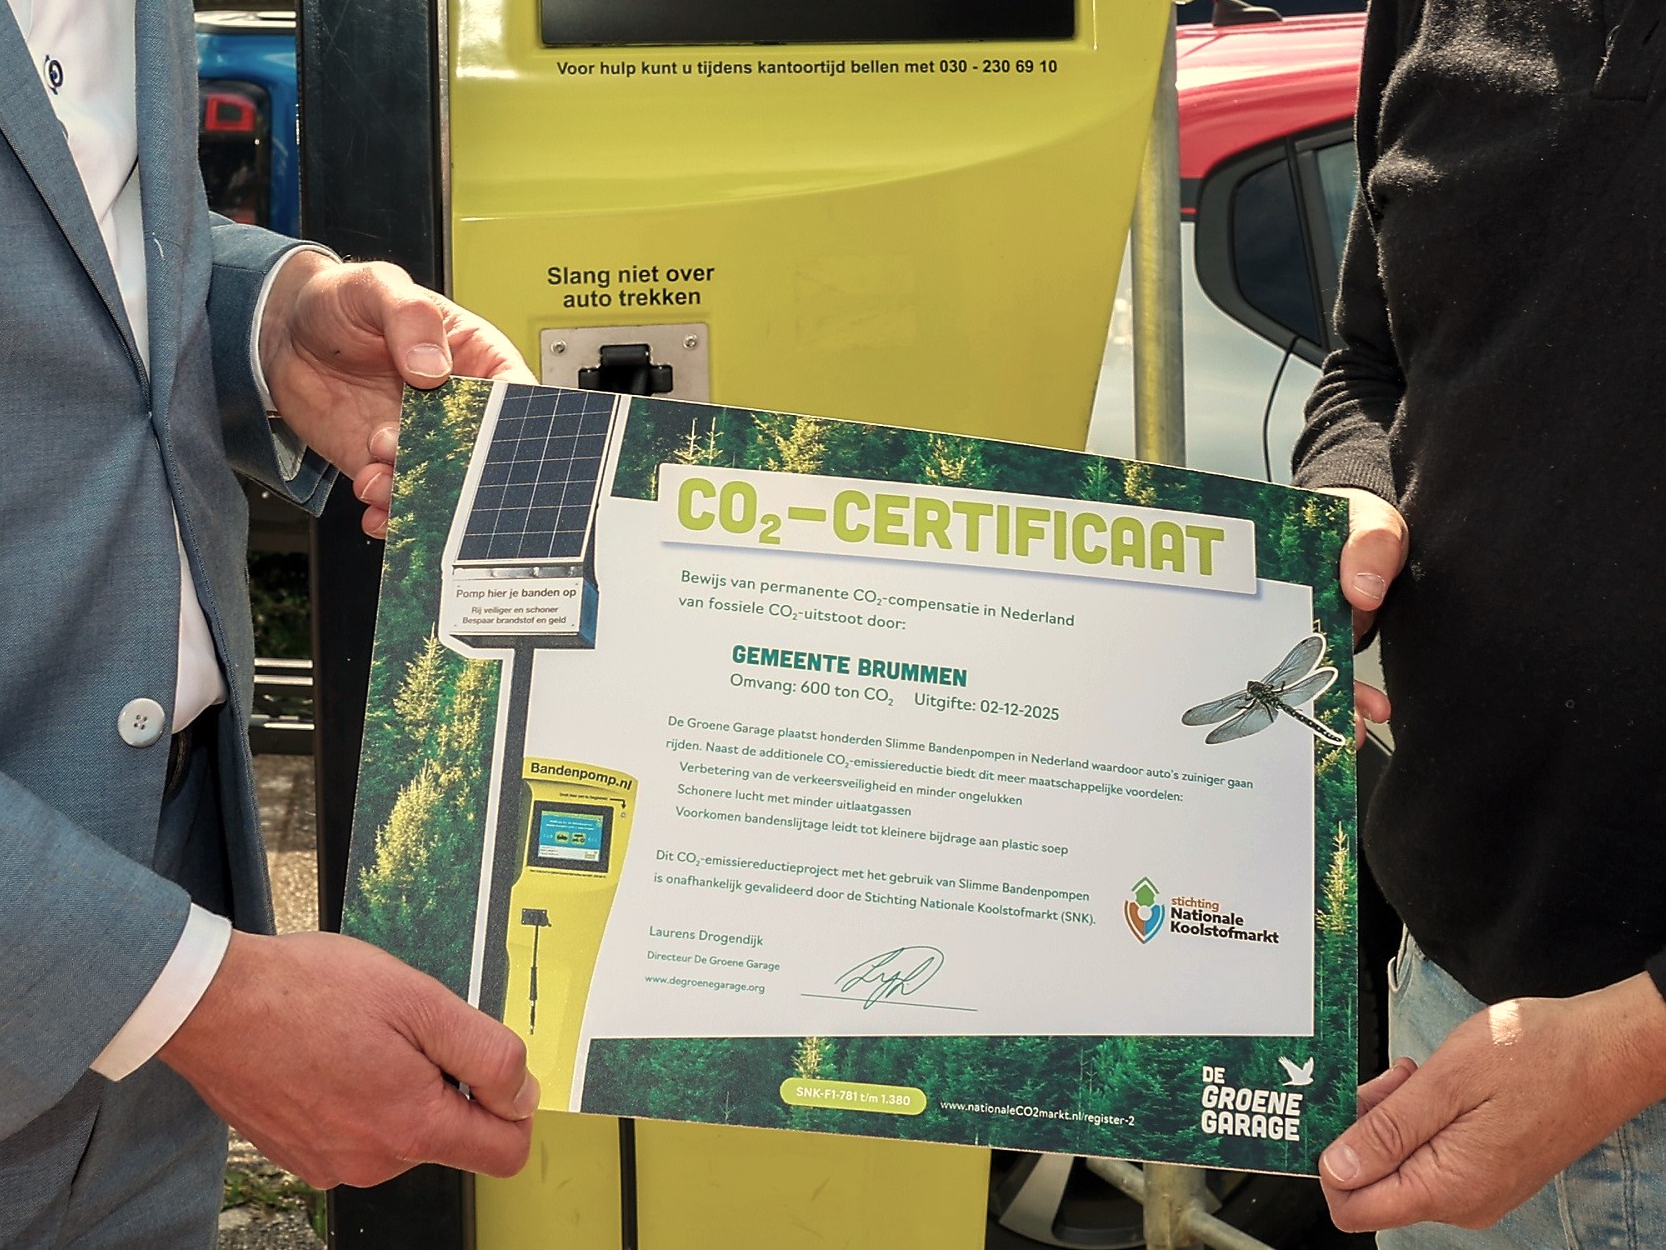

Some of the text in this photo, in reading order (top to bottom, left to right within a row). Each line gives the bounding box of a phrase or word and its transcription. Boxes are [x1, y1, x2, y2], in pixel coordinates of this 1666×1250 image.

[557, 60, 1057, 77] Voor hulp kunt u tijdens kantoortijd bellen met 030 230 69 10
[548, 265, 714, 288] Slang niet over
[564, 288, 700, 308] auto trekken
[456, 588, 577, 600] Pomp hier je banden op
[682, 570, 726, 589] Bewijs
[731, 579, 755, 589] van
[760, 582, 848, 599] permanente
[984, 605, 996, 616] in
[1001, 606, 1074, 626] Nederland
[679, 598, 703, 608] van
[708, 597, 764, 614] fossiele
[867, 615, 906, 630] door:
[733, 645, 967, 687] GEMEENTE BRUMMEN
[730, 673, 796, 695] Omvang:
[801, 681, 830, 695] 600
[834, 686, 859, 698] ton
[915, 692, 976, 711] Uitgifte:
[981, 700, 1059, 720] 02-12-2025
[668, 716, 684, 727] De
[687, 718, 729, 731] Groene
[733, 722, 774, 738] Garage
[778, 728, 817, 740] plaatst
[820, 731, 882, 746] honderden
[885, 738, 925, 751] Slimme
[929, 742, 1015, 762] Bandenpompen
[1018, 752, 1028, 762] in
[1031, 754, 1089, 769] Nederland
[1092, 763, 1144, 775] waardoor
[1182, 773, 1225, 786] zuiniger
[1228, 779, 1253, 789] gaan
[531, 763, 632, 790] Bandenpomp.nl
[666, 739, 702, 751] rijden.
[706, 742, 739, 754] Naast
[742, 746, 756, 756] de
[759, 748, 823, 763] additionele
[946, 766, 976, 778] biedt
[979, 770, 994, 780] dit
[997, 774, 1026, 783] meer
[1029, 778, 1123, 796] maatschappelijke
[1125, 788, 1183, 801] voordelen:
[680, 762, 1022, 805] Verbetering van de verkeersveiligheid en minder ongelukken
[678, 784, 911, 816] Schonere lucht met minder uitlaatgassen
[676, 806, 1068, 857] Voorkomen bandenslijtage leidt tot kleinere bijdrage aan plastic soep
[656, 850, 674, 861] Dit
[842, 870, 864, 879] met
[867, 869, 886, 881] het
[889, 873, 933, 885] gebruik
[936, 879, 955, 887] van
[958, 878, 999, 892] Slimme
[1002, 883, 1089, 902] Bandenpompen
[654, 873, 1095, 926] is onafhankelijk gevalideerd door de Stichting Nationale Koolstofmarkt (SNK).
[1171, 896, 1220, 912] stichting
[1171, 907, 1243, 926] Nationale
[650, 926, 763, 948] Laurens Drogendijk
[1171, 921, 1279, 943] Koolstofmarkt
[648, 951, 780, 972] Directeur De Groene Garage
[645, 976, 765, 994] www.degroenegarage.org
[1202, 1065, 1226, 1084] DE
[860, 1093, 878, 1103] t/m
[881, 1094, 911, 1106] 1.380
[1201, 1084, 1304, 1117] GROENE
[1201, 1109, 1300, 1142] GARAGE
